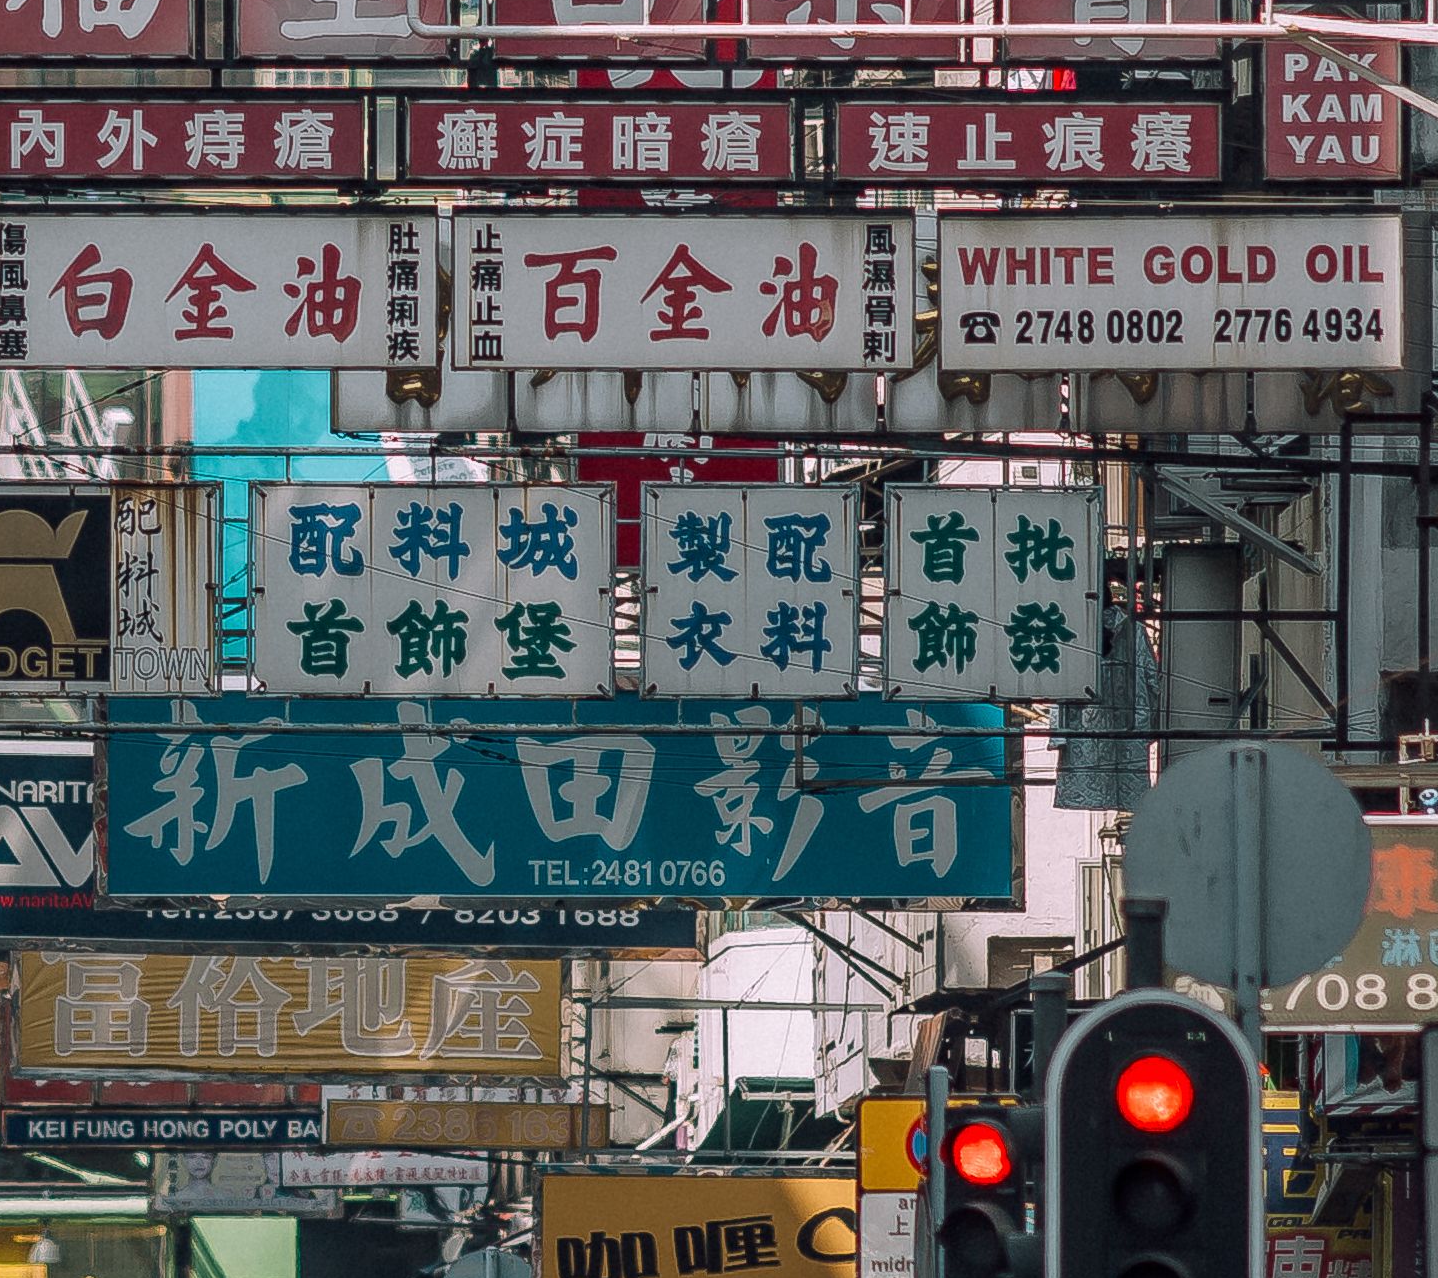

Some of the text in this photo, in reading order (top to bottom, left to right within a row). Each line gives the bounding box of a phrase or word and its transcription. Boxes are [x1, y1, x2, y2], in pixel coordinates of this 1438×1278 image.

[1282, 52, 1378, 83] PAK
[1281, 93, 1383, 124] KAM
[1284, 134, 1381, 165] YAU
[957, 244, 1385, 287] WHITE GOLD OIL
[47, 243, 364, 344] 白金油
[470, 224, 505, 363] 止痛止血
[522, 243, 842, 344] 百金油
[1014, 307, 1385, 347] 2748 0802 2776 4934
[286, 501, 579, 581] 配料城
[285, 598, 579, 682] 首飾堡
[114, 647, 210, 682] TOWN
[1260, 973, 1389, 1012] 708
[28, 1119, 322, 1139] KEI FUNG HONG POLY BA
